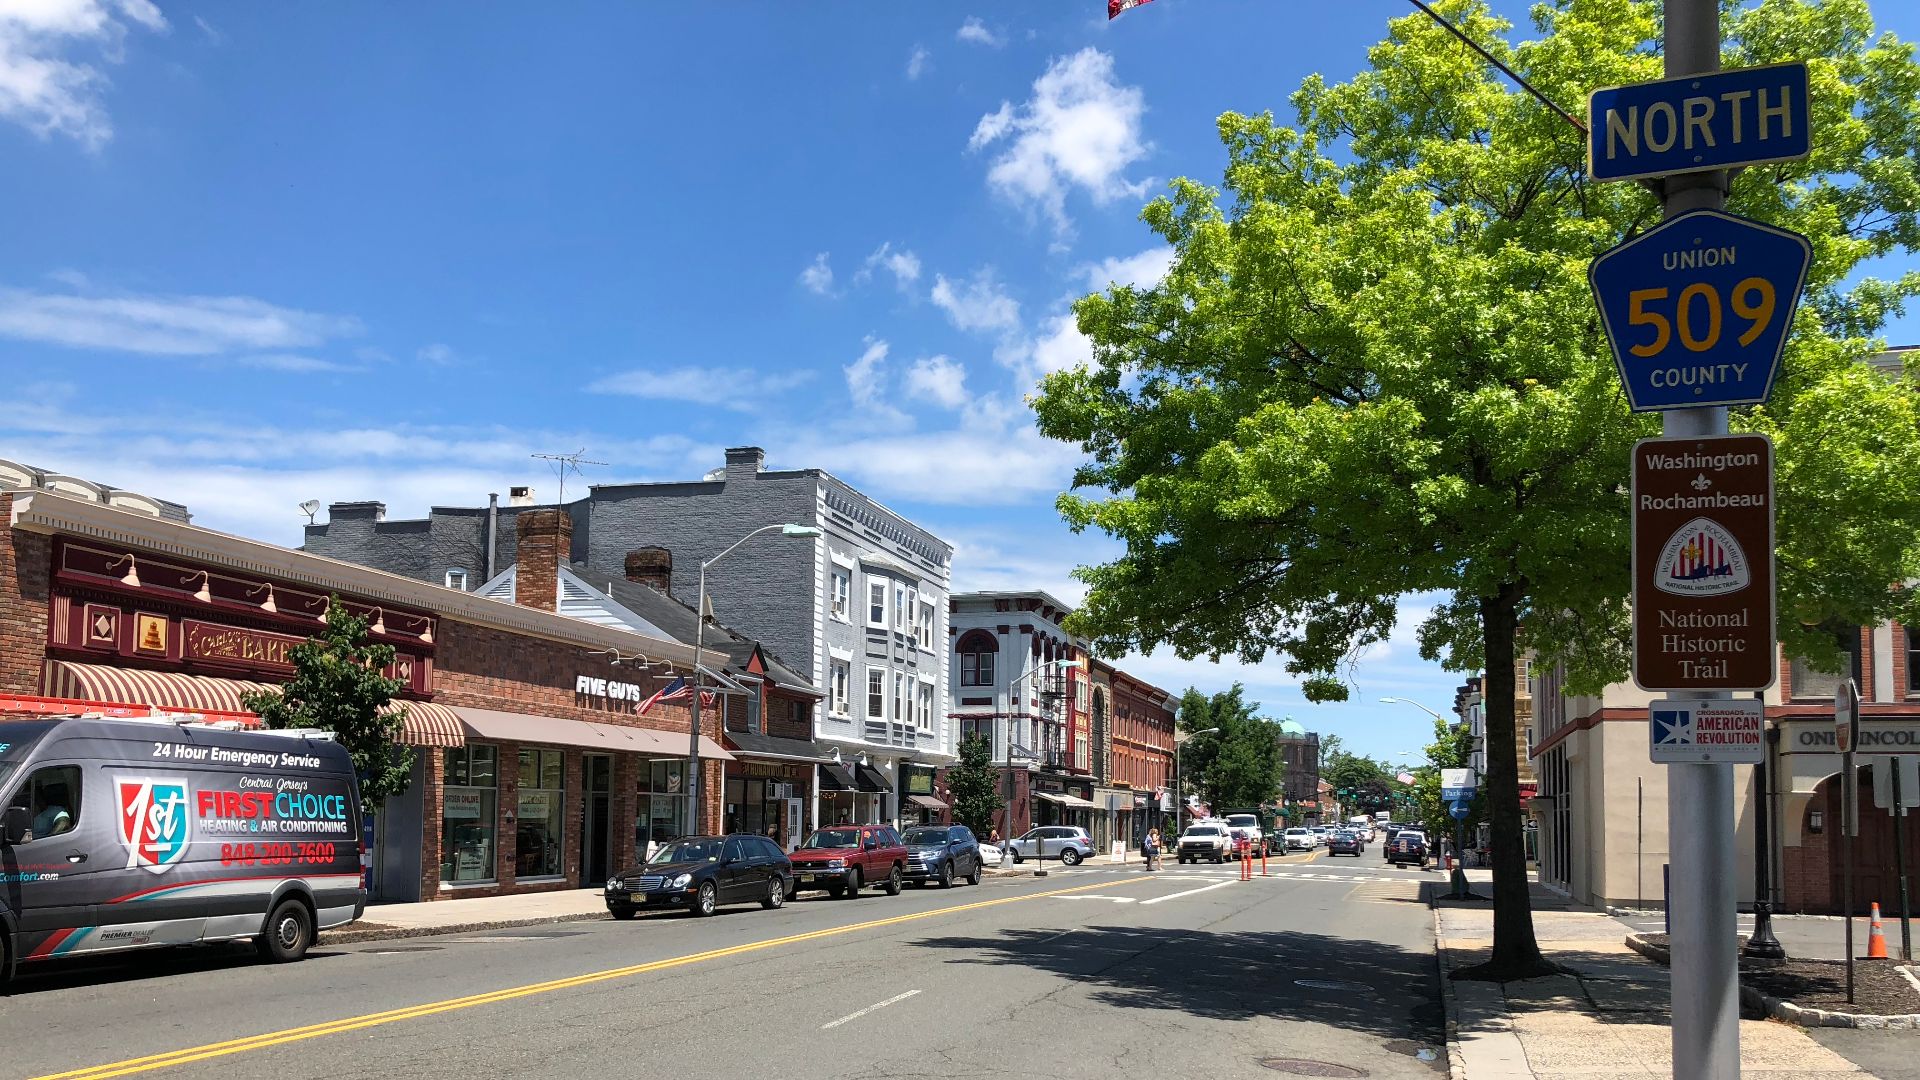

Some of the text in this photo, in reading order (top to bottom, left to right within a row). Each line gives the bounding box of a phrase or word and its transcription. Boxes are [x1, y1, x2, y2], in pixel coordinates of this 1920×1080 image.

[1606, 85, 1791, 160] NORTH
[1663, 246, 1736, 270] UNION
[1629, 277, 1776, 357] 509
[1650, 363, 1748, 388] COUNTY
[1645, 452, 1759, 471] Washington
[1641, 491, 1764, 510] Rochambeau
[1662, 524, 1742, 572] WASHINGTON ROCHAMBEAU
[1665, 581, 1694, 590] NATIONAL
[1722, 580, 1739, 588] TRAIL
[1658, 608, 1750, 628] National
[242, 636, 291, 663] BAKE
[1661, 633, 1745, 653] Historic
[1678, 660, 1728, 678] Trail
[576, 675, 640, 702] FIVE GUYS
[1696, 716, 1759, 730] AMERICAN
[1696, 732, 1760, 745] REVOLUTION
[1859, 730, 1920, 746] INCOL
[153, 743, 321, 768] 24 Hour Emergency Service
[239, 776, 308, 793] Central Jersey's
[1445, 790, 1473, 798] Parking
[197, 790, 346, 820] FIRST CHOICE
[118, 777, 189, 870] 1st
[200, 820, 347, 834] HEATING & AIR CONDITIONING
[220, 842, 335, 866] 848-200-7600
[101, 931, 132, 940] PREMIER
